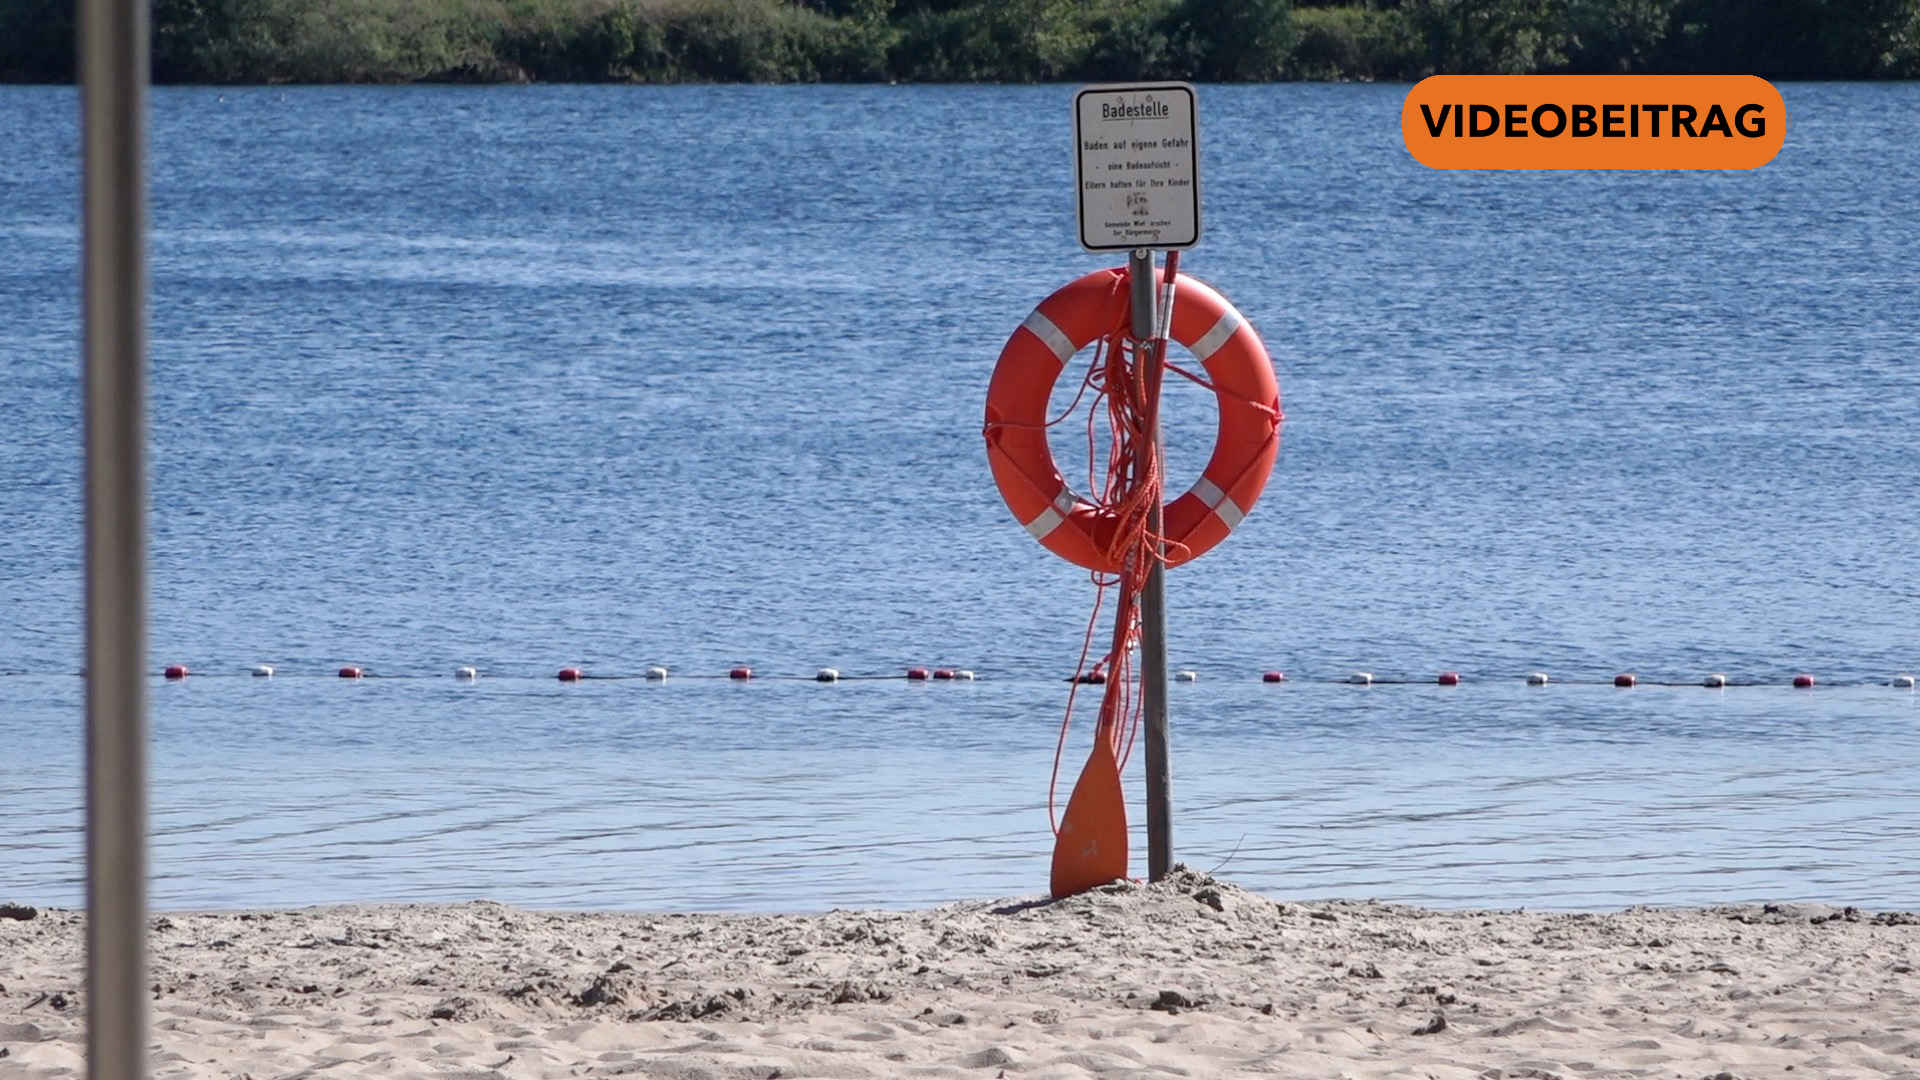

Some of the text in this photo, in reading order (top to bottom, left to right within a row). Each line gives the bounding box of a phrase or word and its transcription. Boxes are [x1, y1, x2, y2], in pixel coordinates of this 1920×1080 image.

[1102, 101, 1169, 118] Badestelle
[1084, 137, 1189, 151] Baden auf eigene Gefahr
[1110, 180, 1132, 189] haften
[1168, 177, 1190, 187] Kinder
